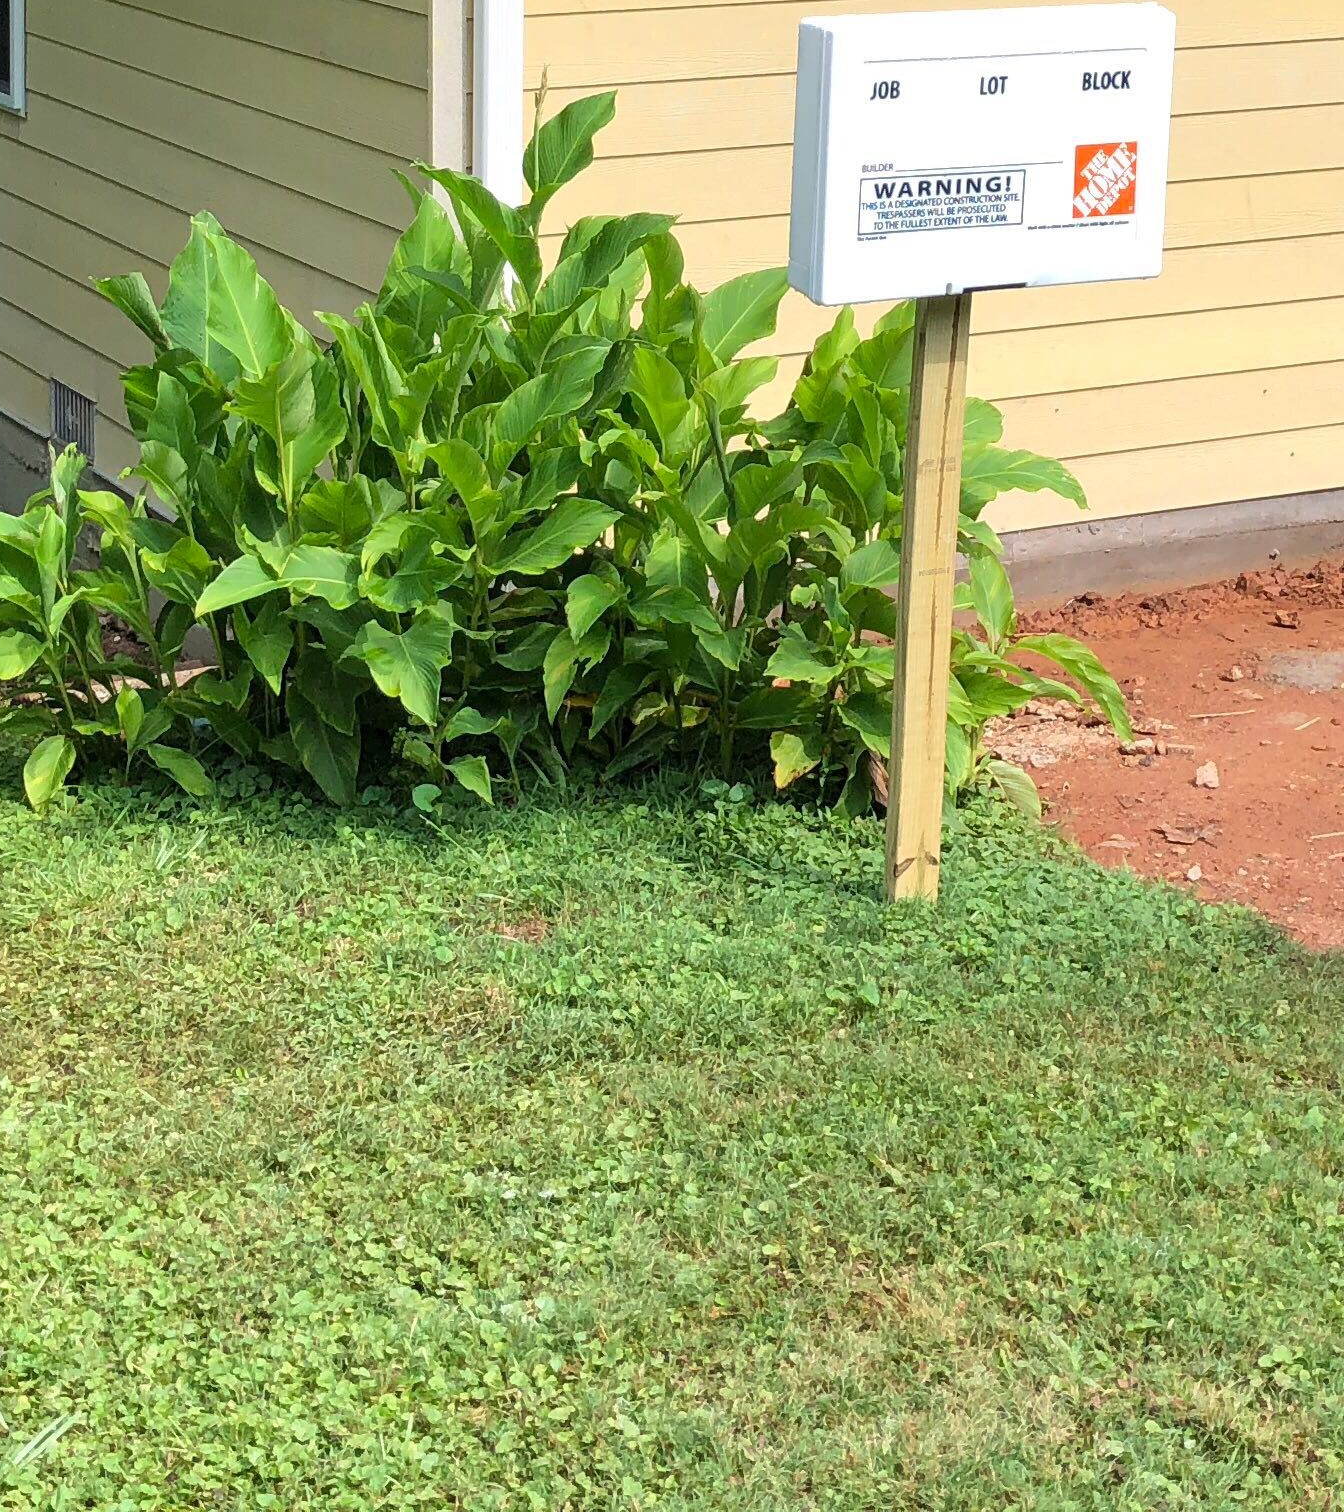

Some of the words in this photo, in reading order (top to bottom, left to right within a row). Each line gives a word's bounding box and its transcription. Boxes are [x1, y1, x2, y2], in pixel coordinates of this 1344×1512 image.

[869, 81, 901, 101] JOB
[979, 75, 1009, 96] LOT
[1082, 70, 1132, 91] BLOCK
[861, 163, 894, 173] BUILDER
[1079, 148, 1109, 180] THE
[874, 175, 1012, 199] WARNING!
[1073, 142, 1137, 217] HOME
[1095, 166, 1136, 215] DEPOT
[861, 202, 878, 210] THIS
[879, 201, 886, 209] IS
[895, 198, 942, 208] DESIGNATED
[943, 194, 1002, 205] CONSTRUCTION
[876, 208, 926, 220] TRESPASSERS
[927, 207, 944, 216] WILL
[946, 206, 955, 215] BE
[957, 204, 1006, 214] PROSECUTED
[873, 221, 884, 230] TO
[885, 220, 900, 230] THE
[900, 218, 933, 228] FULLEST
[933, 216, 962, 227] EXTENT
[963, 215, 974, 224] OF
[974, 214, 990, 224] THE
